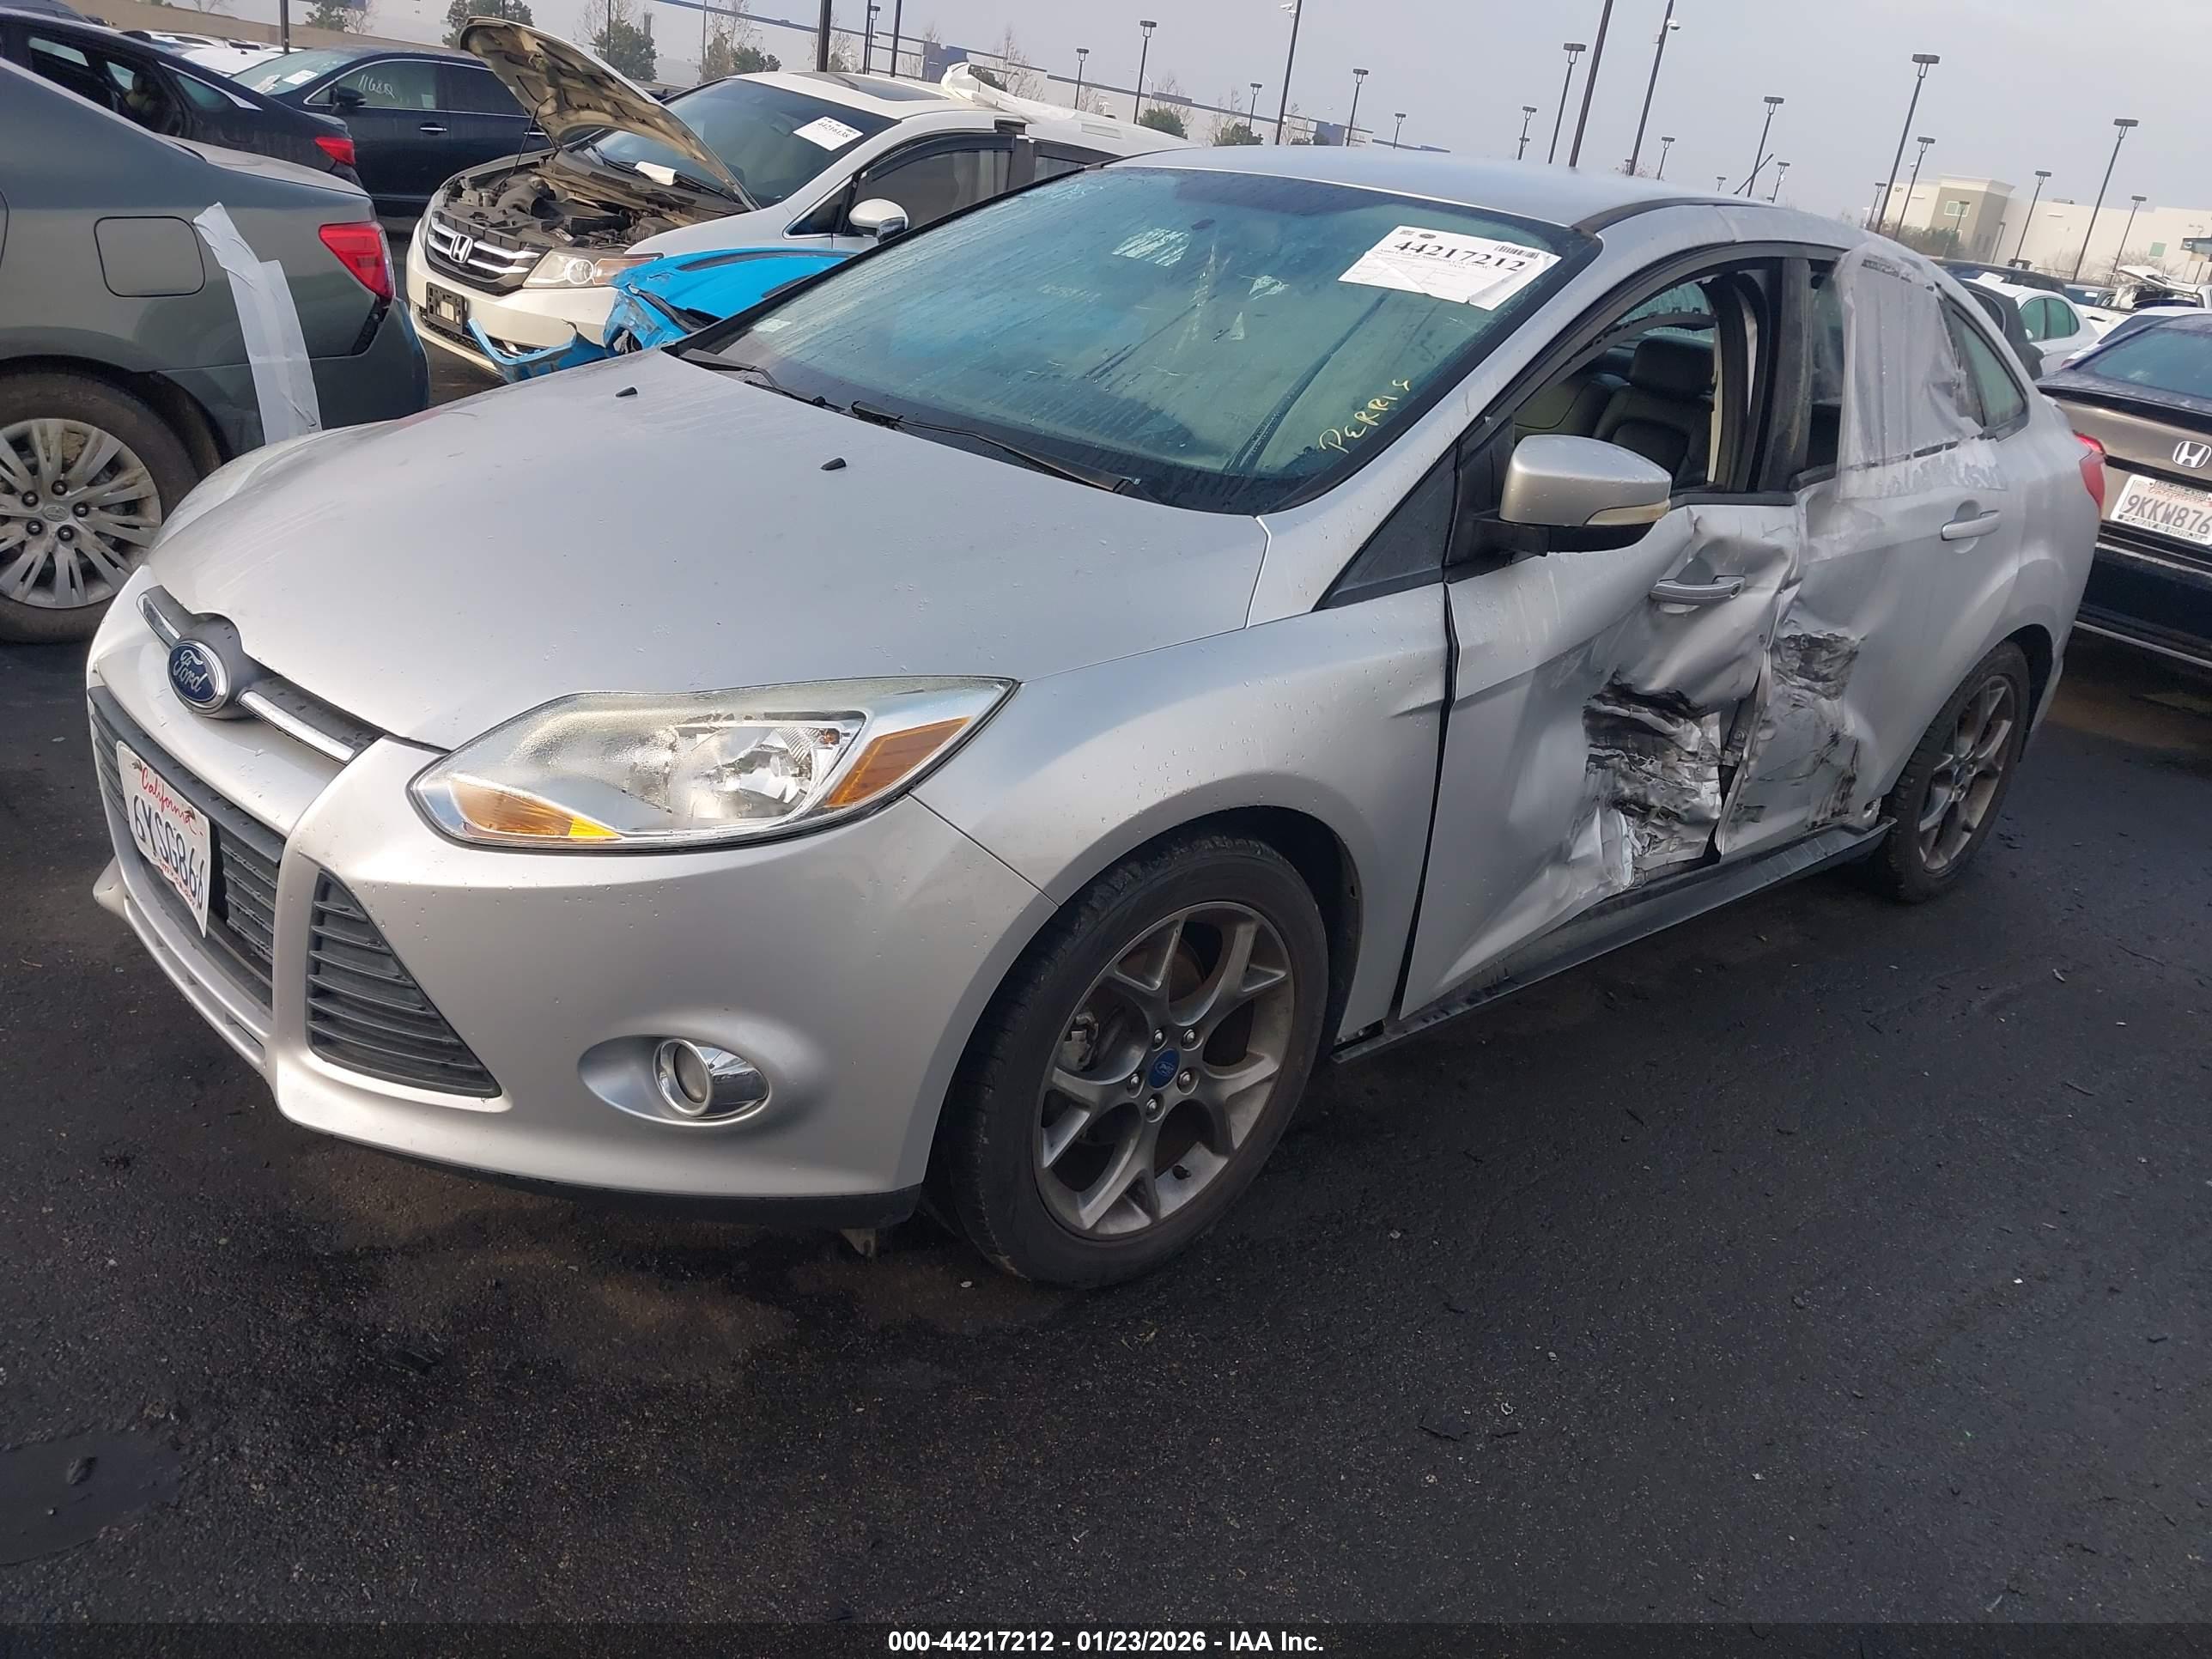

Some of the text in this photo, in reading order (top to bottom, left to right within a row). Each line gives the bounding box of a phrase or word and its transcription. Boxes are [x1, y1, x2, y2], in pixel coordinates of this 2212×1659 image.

[1394, 241, 1526, 272] 44217212
[2123, 494, 2212, 534] 9KKW876
[173, 649, 208, 693] Ford
[141, 767, 198, 836] California
[133, 794, 205, 910] 6YSG866
